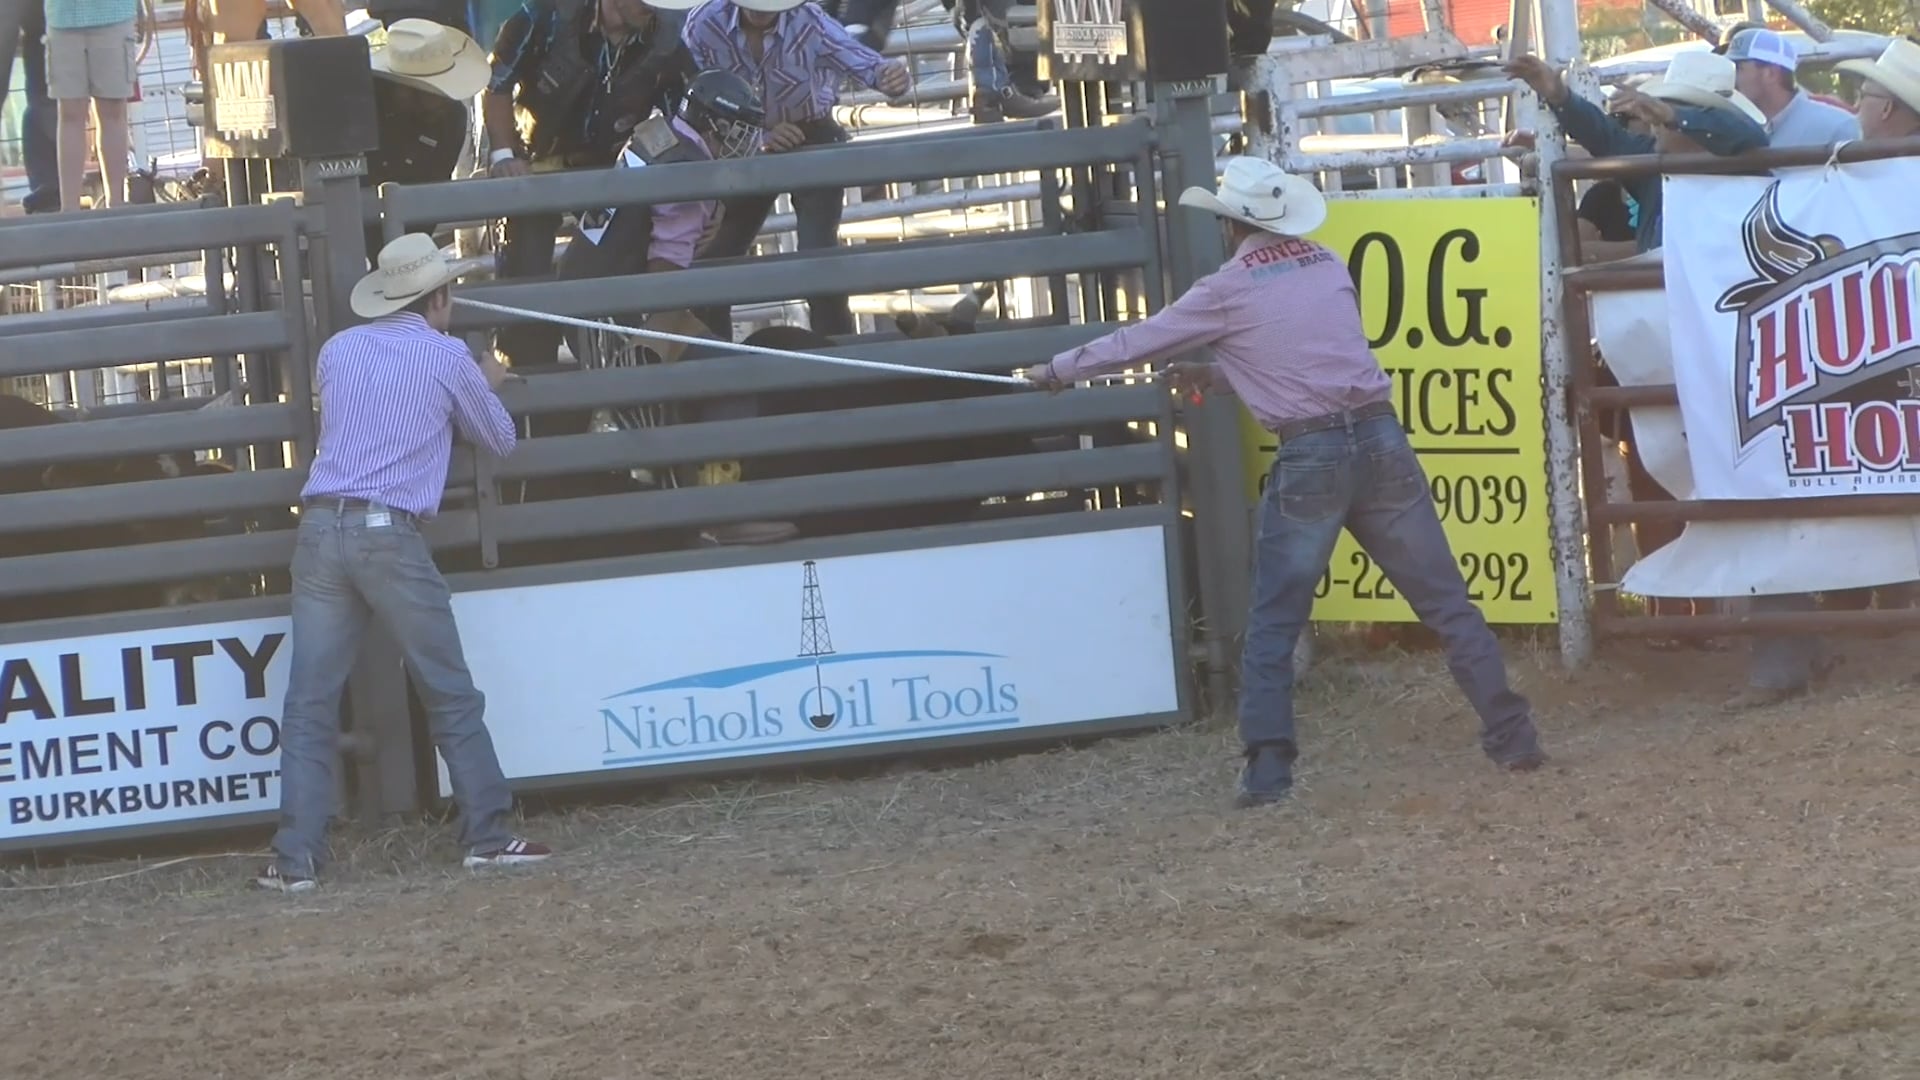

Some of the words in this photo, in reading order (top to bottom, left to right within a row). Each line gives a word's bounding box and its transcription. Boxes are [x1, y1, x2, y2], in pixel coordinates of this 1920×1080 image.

[1384, 368, 1516, 435] ICES
[1788, 477, 1838, 489] BULL
[0, 632, 286, 724] ALITY
[199, 716, 281, 761] CO
[599, 689, 784, 754] Nichols
[798, 678, 875, 732] Oil
[892, 666, 1019, 723] Tools
[10, 770, 281, 825] BURKBURNET
